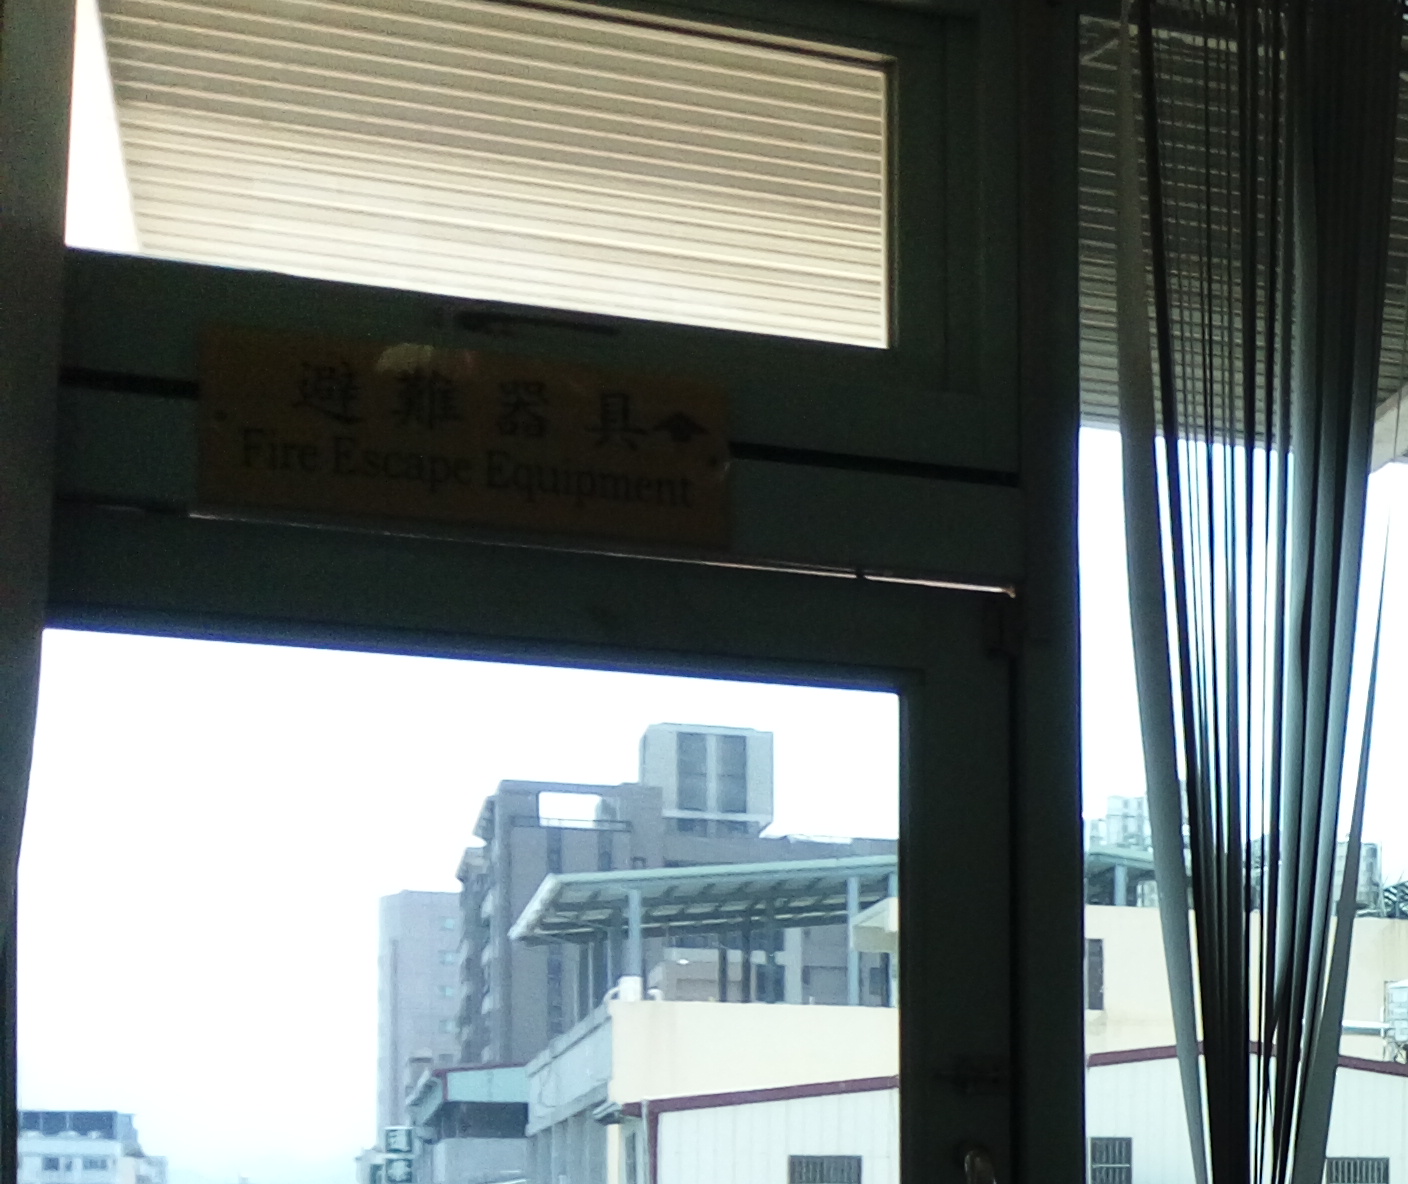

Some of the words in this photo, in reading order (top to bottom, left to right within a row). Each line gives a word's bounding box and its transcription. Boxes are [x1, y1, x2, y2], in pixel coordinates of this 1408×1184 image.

[293, 362, 648, 451] 避難器具
[239, 427, 319, 473] Fire
[332, 435, 474, 494] Escape
[485, 449, 697, 508] Equipment
